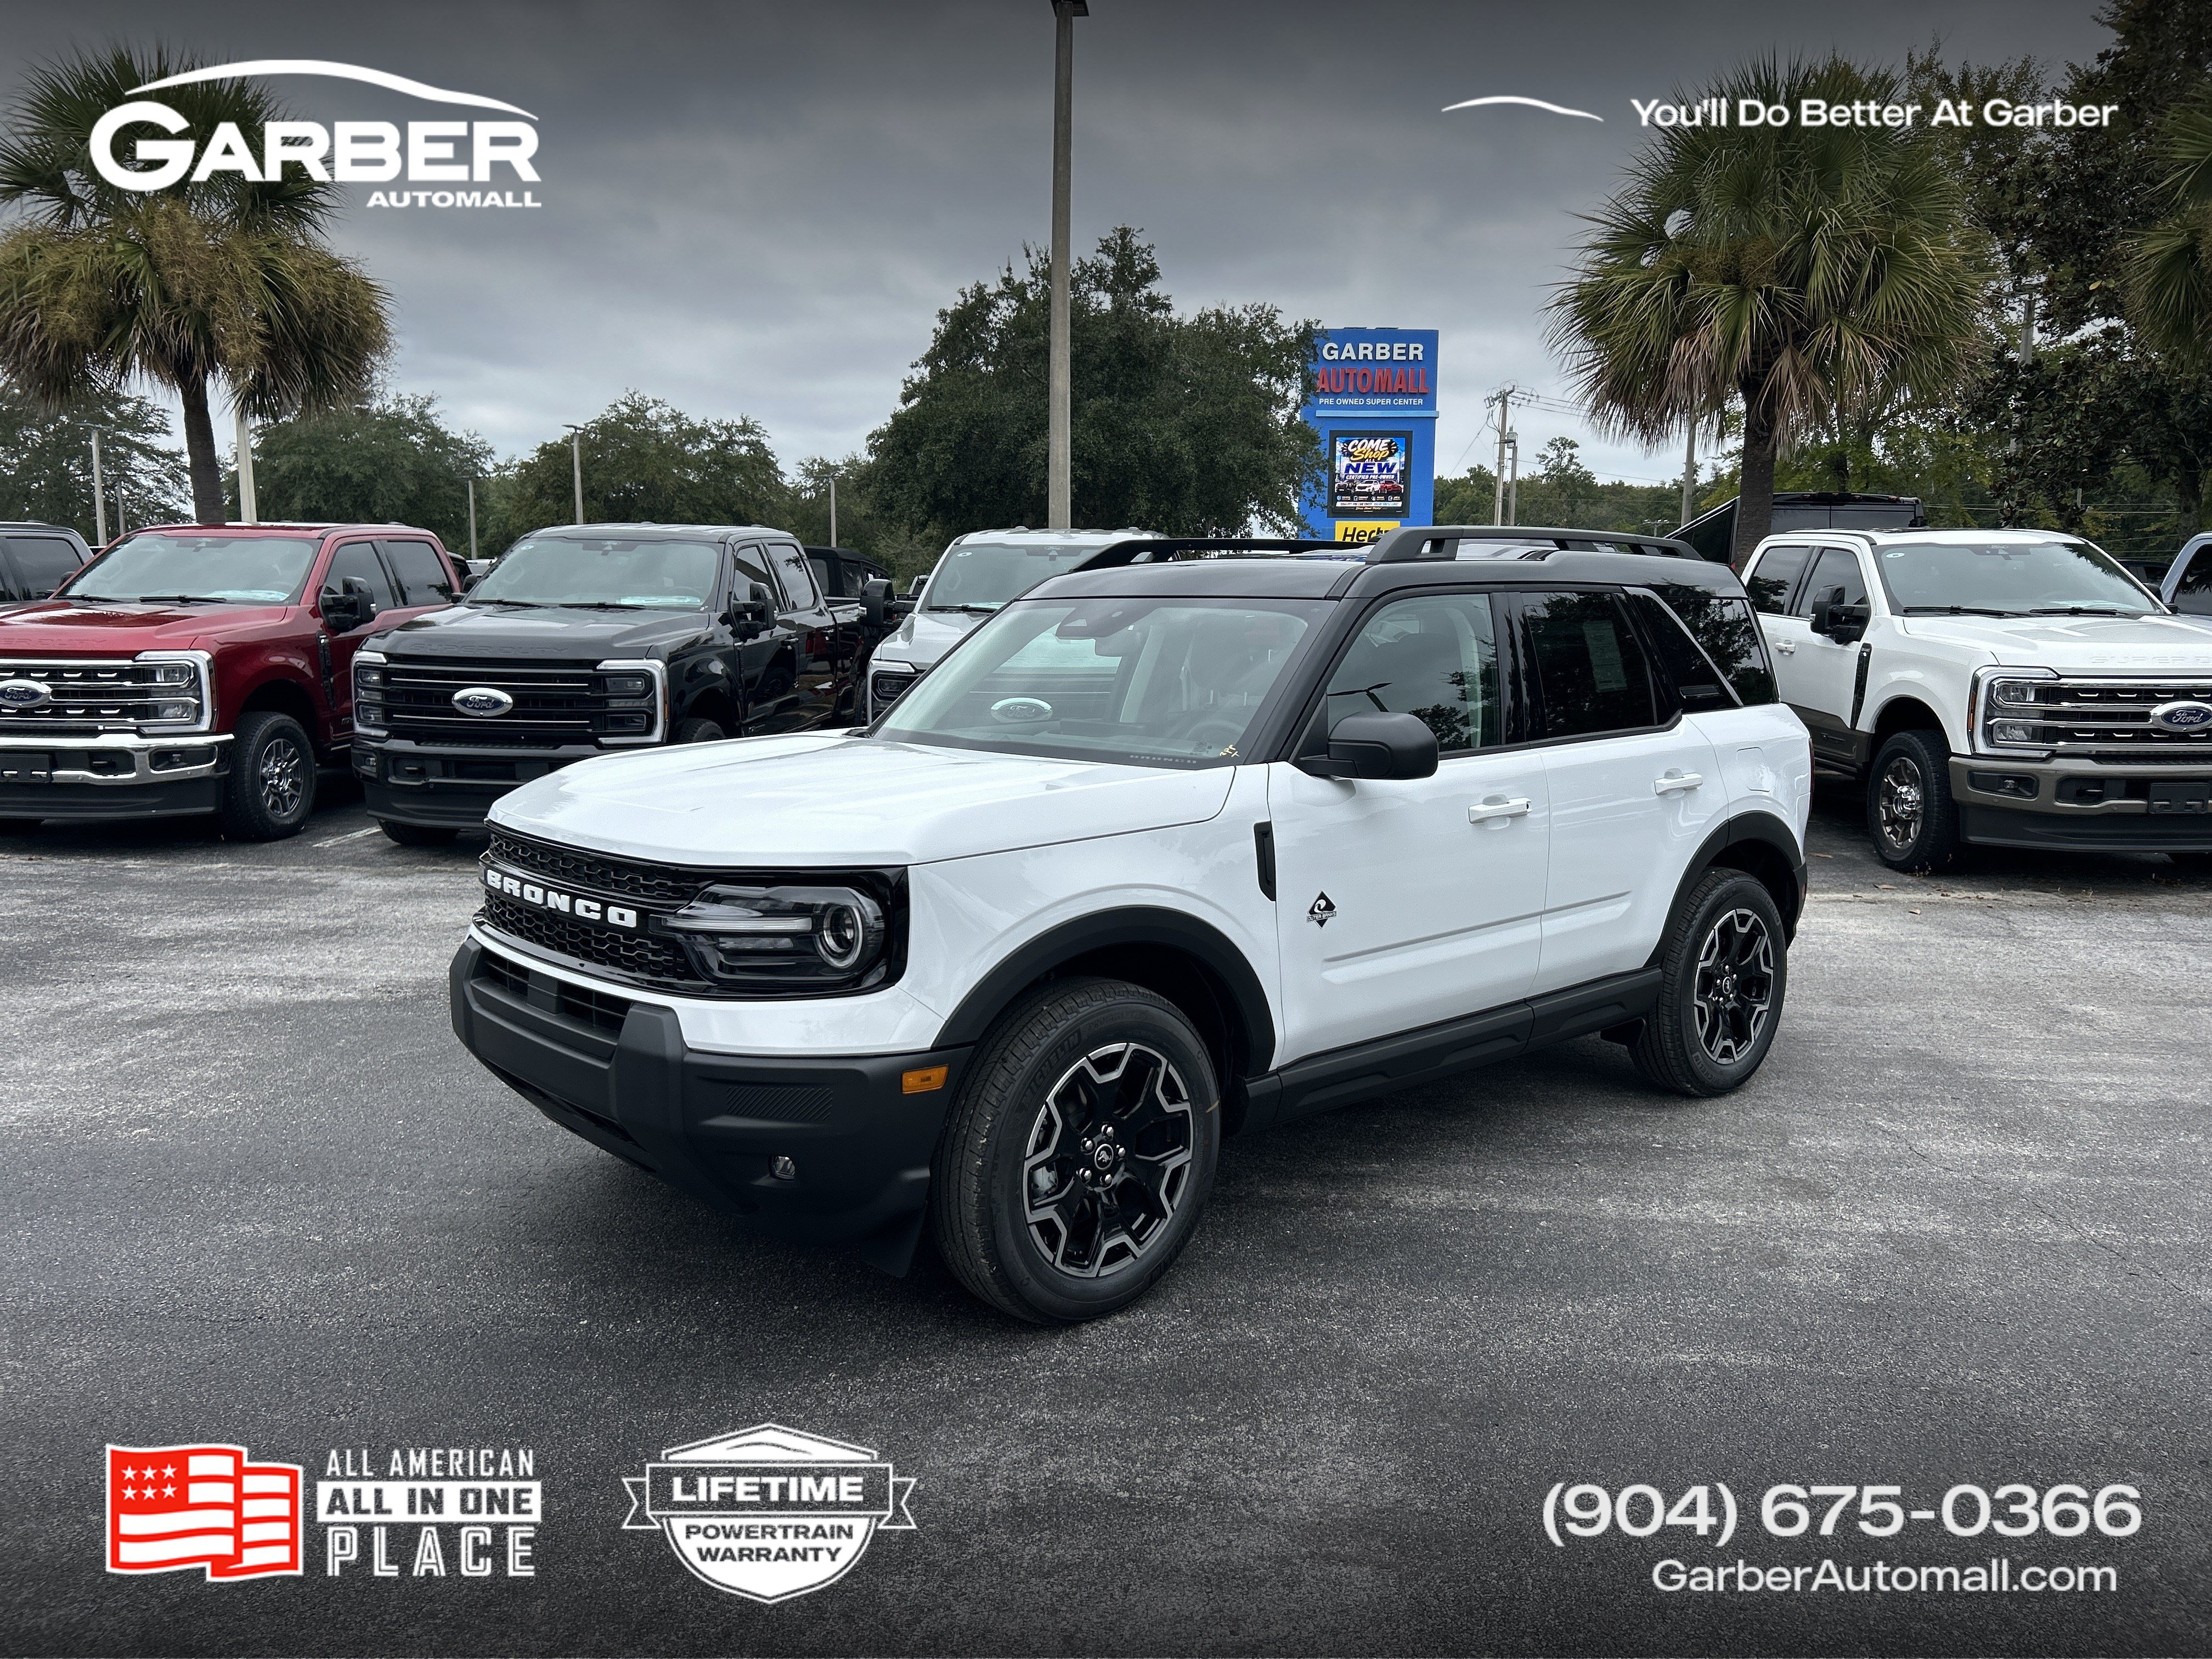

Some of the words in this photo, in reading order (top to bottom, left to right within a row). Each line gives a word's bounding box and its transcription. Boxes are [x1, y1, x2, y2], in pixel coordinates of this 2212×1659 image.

[1323, 342, 1424, 360] GARBER
[1318, 368, 1429, 393] AUTOMALL
[1348, 439, 1390, 452] COME
[1350, 449, 1390, 461] Shop
[1344, 462, 1397, 473] NEW
[4, 687, 32, 699] Ford
[466, 695, 496, 709] Ford
[2172, 709, 2203, 724] Ford
[487, 869, 637, 928] BRONCO
